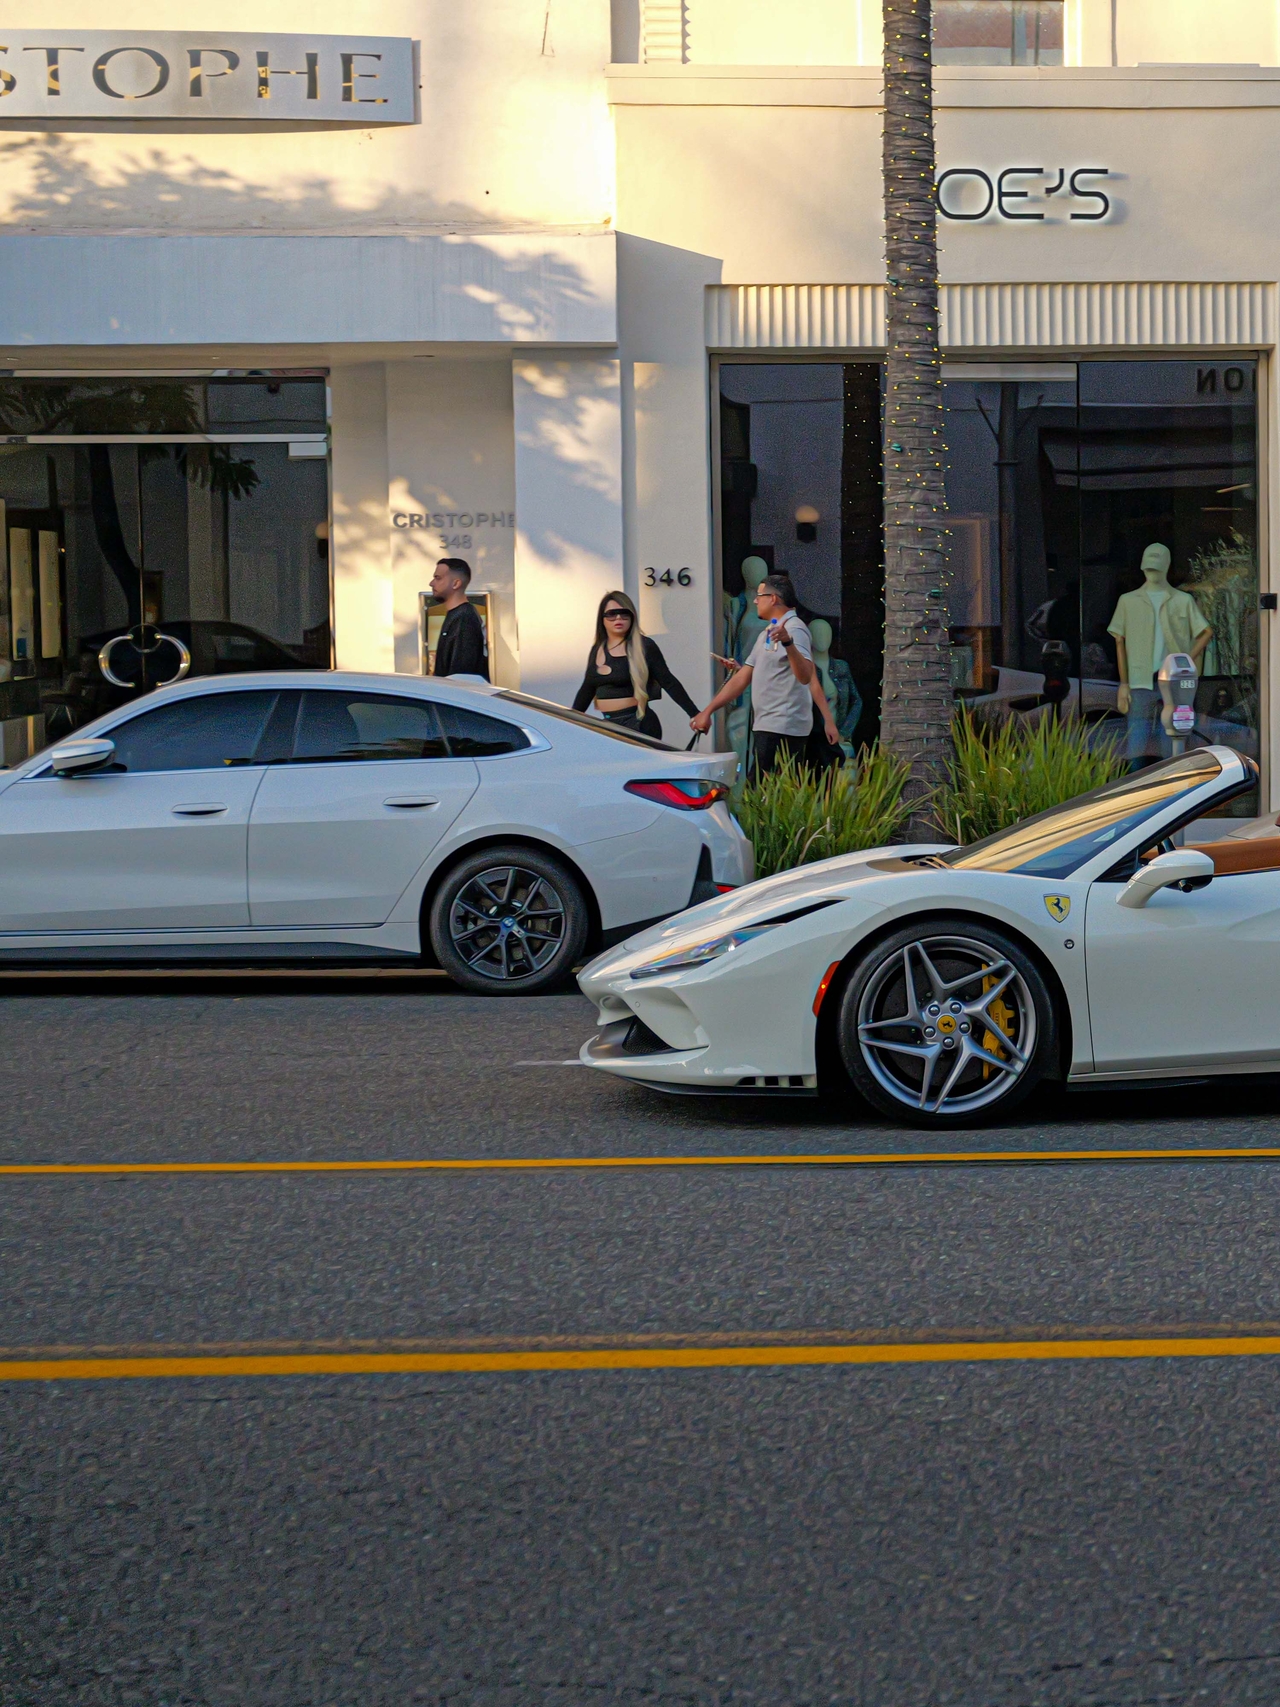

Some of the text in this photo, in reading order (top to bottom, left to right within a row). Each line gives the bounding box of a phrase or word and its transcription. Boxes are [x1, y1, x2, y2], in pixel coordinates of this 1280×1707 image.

[936, 167, 1110, 220] OE'S
[392, 512, 515, 529] CRISTOPHE
[439, 534, 472, 550] 348
[643, 566, 692, 588] 346
